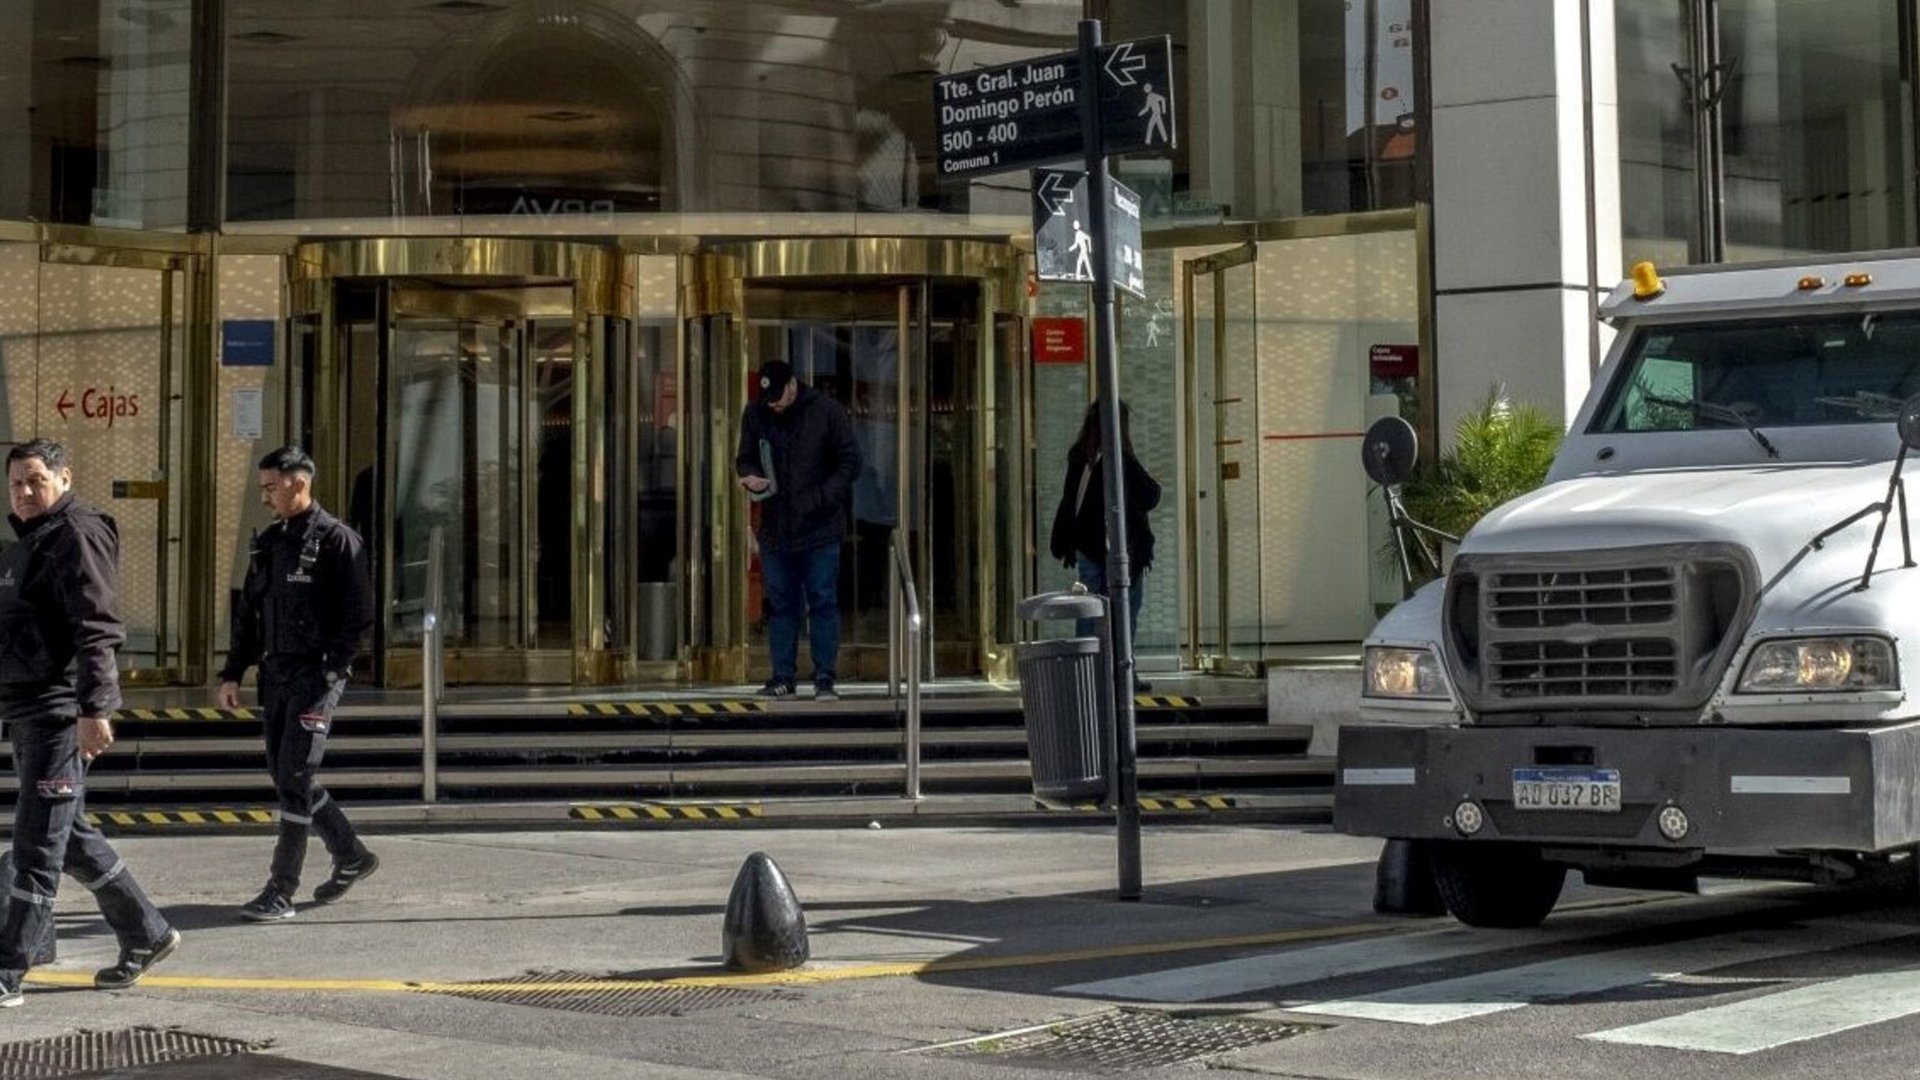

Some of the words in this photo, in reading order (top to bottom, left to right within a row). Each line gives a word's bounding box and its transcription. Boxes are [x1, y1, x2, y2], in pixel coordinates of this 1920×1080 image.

[940, 80, 973, 100] Tte.
[977, 69, 1017, 93] Gral.
[1022, 64, 1065, 85] Juan
[942, 98, 1019, 125] Domingo
[1024, 85, 1075, 110] Perón
[943, 130, 973, 152] 500
[987, 122, 1018, 144] 400
[944, 155, 990, 173] Comuna
[992, 152, 999, 163] 1
[81, 386, 139, 429] Cajas
[1547, 784, 1584, 806] 037
